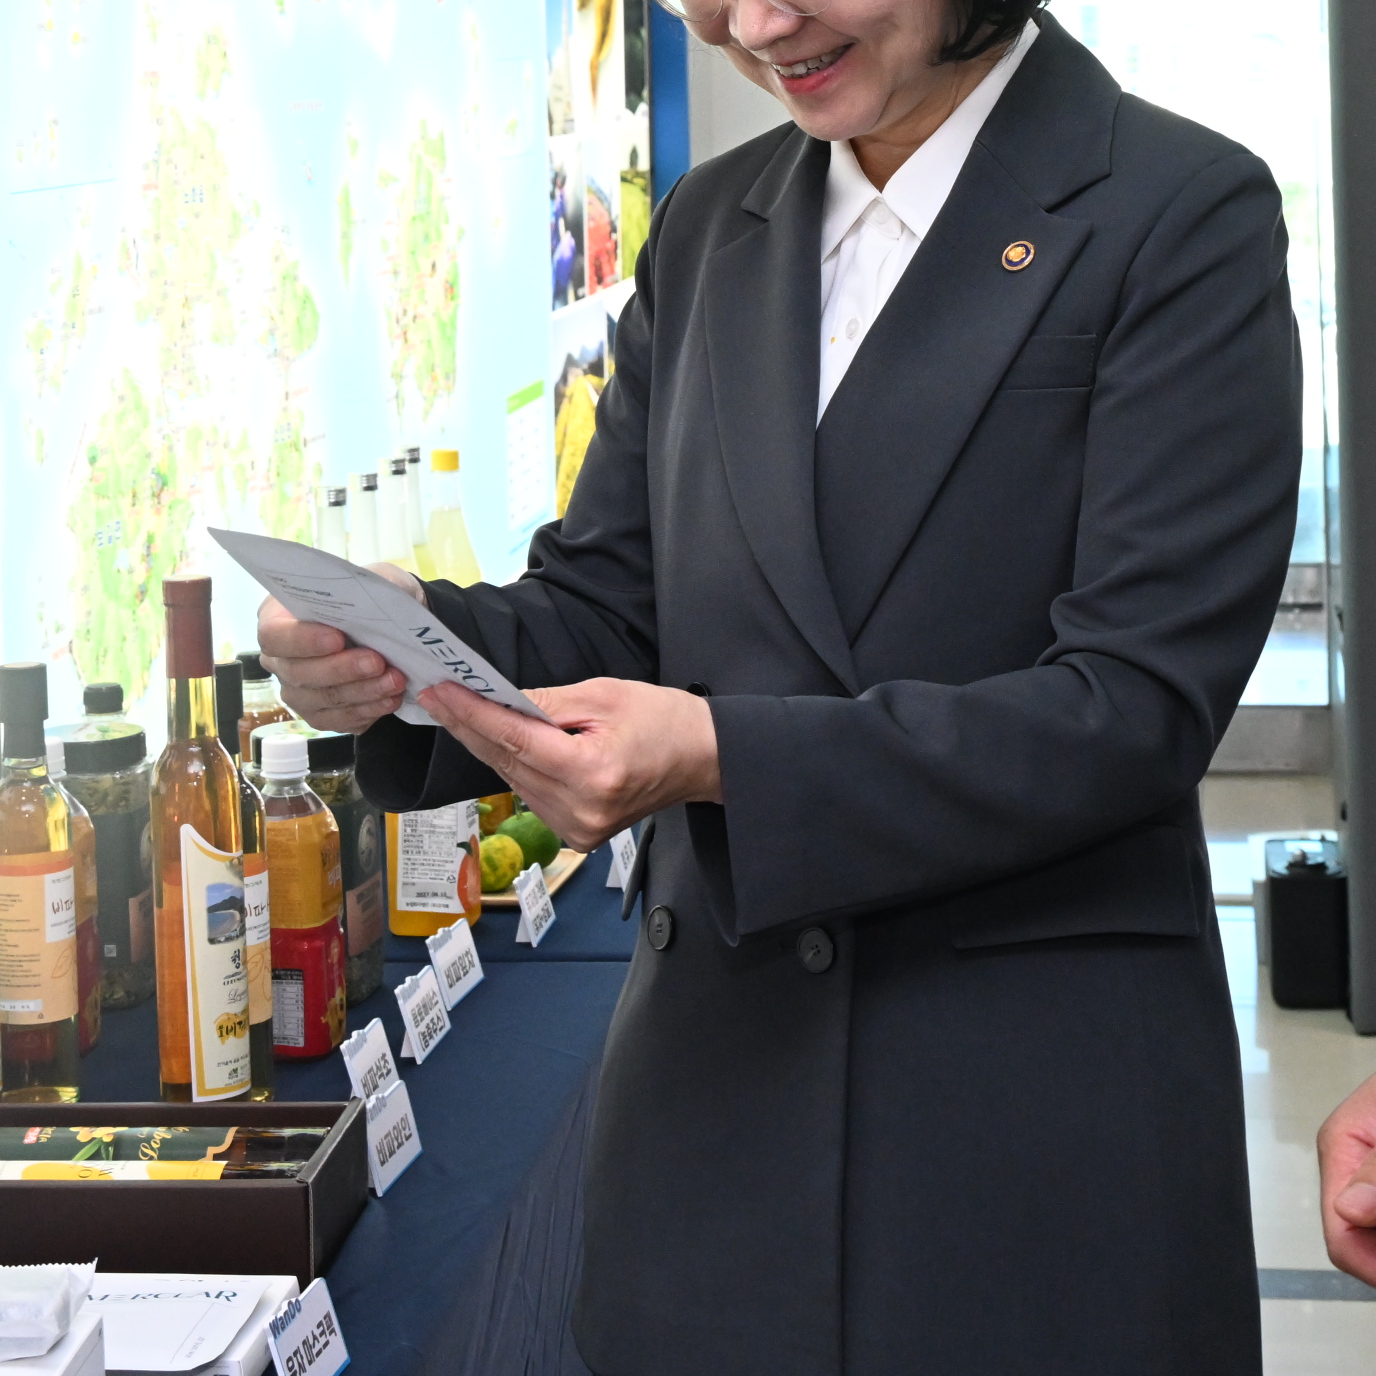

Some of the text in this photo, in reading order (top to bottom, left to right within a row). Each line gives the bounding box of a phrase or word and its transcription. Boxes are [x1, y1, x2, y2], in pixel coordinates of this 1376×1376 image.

[367, 1096, 388, 1124] anDo
[375, 1113, 413, 1167] 비파와인
[269, 1297, 303, 1340] WanDo
[301, 1309, 338, 1367] 마스크팩
